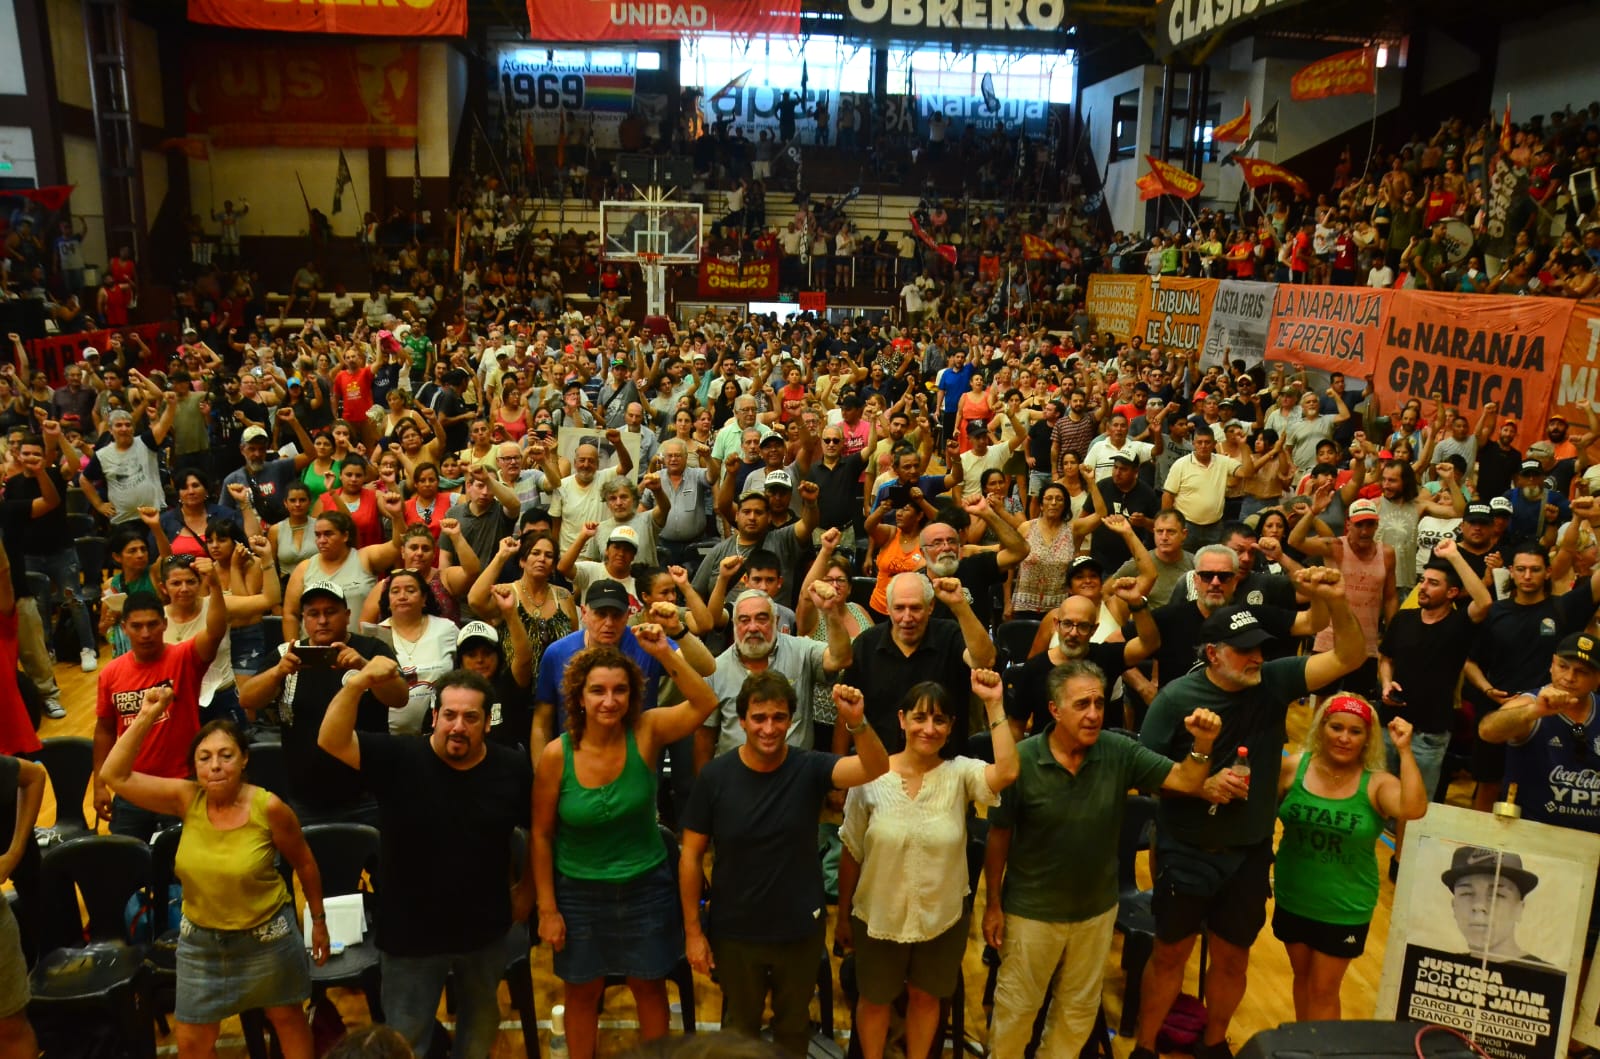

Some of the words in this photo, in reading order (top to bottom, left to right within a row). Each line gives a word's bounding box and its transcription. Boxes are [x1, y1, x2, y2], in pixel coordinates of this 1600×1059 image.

[610, 3, 708, 27] UNIDAD
[848, 0, 1065, 31] OBRERO
[501, 73, 584, 111] 1969
[706, 262, 771, 276] PARIDO
[1150, 282, 1200, 315] TRIBUNA
[1215, 288, 1239, 314] LISTA
[1239, 293, 1266, 319] GRIS
[1276, 289, 1296, 317] LA
[1300, 291, 1381, 328] NARANJA
[1145, 320, 1159, 344] DE
[1273, 320, 1289, 348] DE
[1289, 322, 1365, 363] PRENSA
[1386, 316, 1409, 347] La
[1413, 321, 1546, 372] NARANJA
[1388, 356, 1524, 420] GRAFICA
[1287, 803, 1364, 831] STAFF
[1418, 956, 1504, 985] JUSTICIA
[1414, 980, 1487, 1007] NESTOR
[1416, 968, 1453, 987] POR
[1455, 975, 1546, 1006] CRISTIAN
[1410, 1007, 1461, 1028] FRANCO
[1412, 994, 1458, 1015] CARCEL
[1480, 1012, 1548, 1034] SARGENTO
